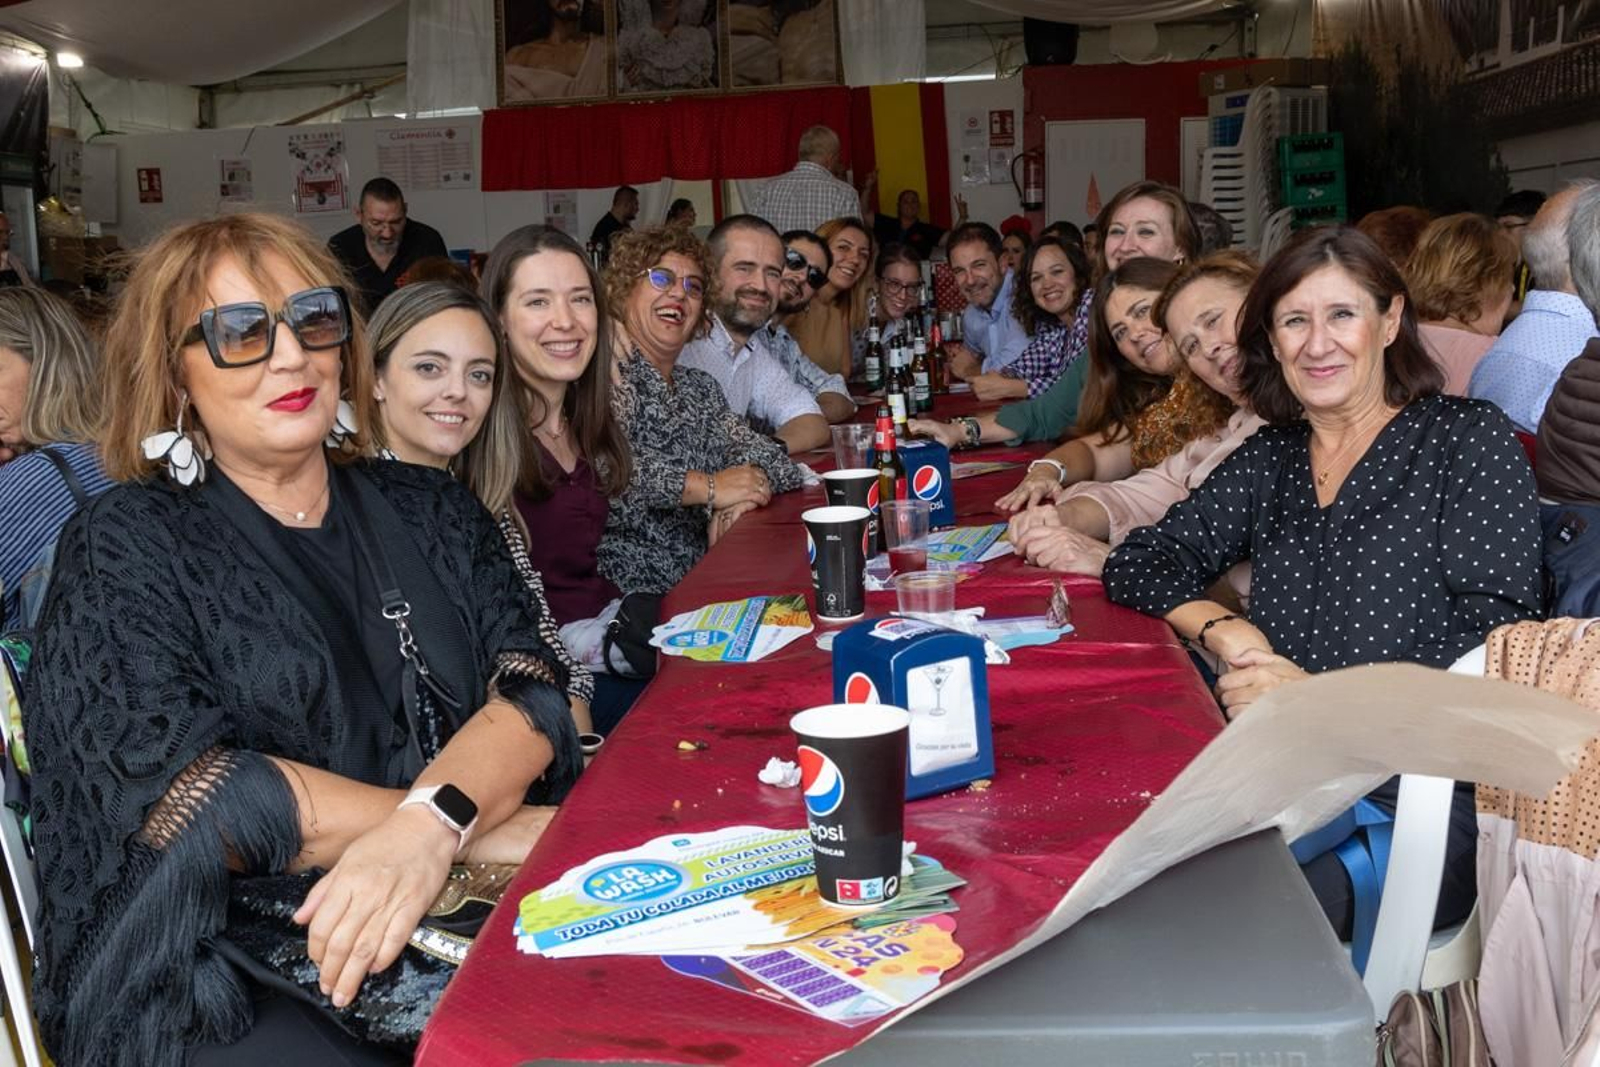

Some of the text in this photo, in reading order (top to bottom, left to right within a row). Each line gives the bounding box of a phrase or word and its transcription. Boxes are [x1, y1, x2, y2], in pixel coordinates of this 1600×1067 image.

[929, 500, 943, 512] psi
[809, 821, 844, 843] epsi
[594, 868, 677, 899] WASH
[608, 867, 646, 882] LA
[557, 918, 611, 940] TODA
[615, 909, 641, 924] TU
[645, 890, 717, 915] COLADA
[721, 883, 746, 895] AL
[746, 865, 807, 887] MEJOR
